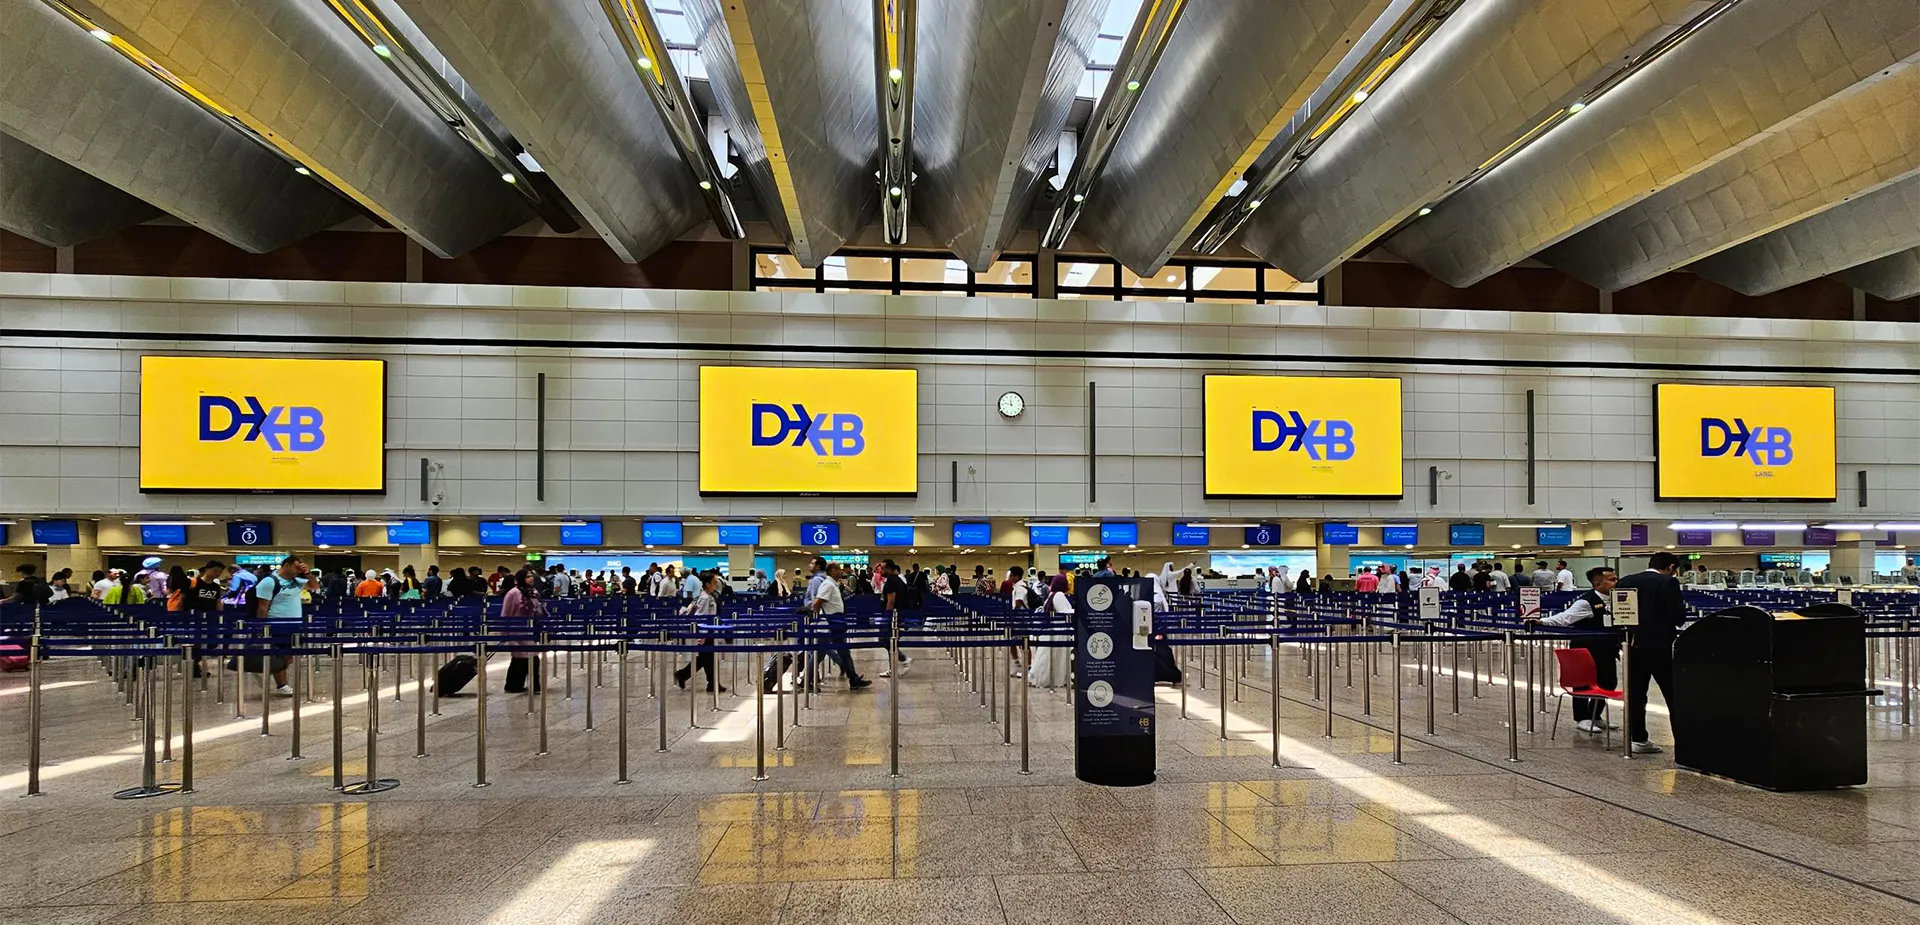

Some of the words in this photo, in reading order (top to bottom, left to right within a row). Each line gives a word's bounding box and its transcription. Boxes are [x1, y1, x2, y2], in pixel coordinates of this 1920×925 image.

[199, 395, 326, 452] DXB
[751, 403, 866, 457] DXB
[1252, 410, 1356, 461] DXB
[1701, 417, 1794, 466] DXB
[198, 589, 217, 598] EA7
